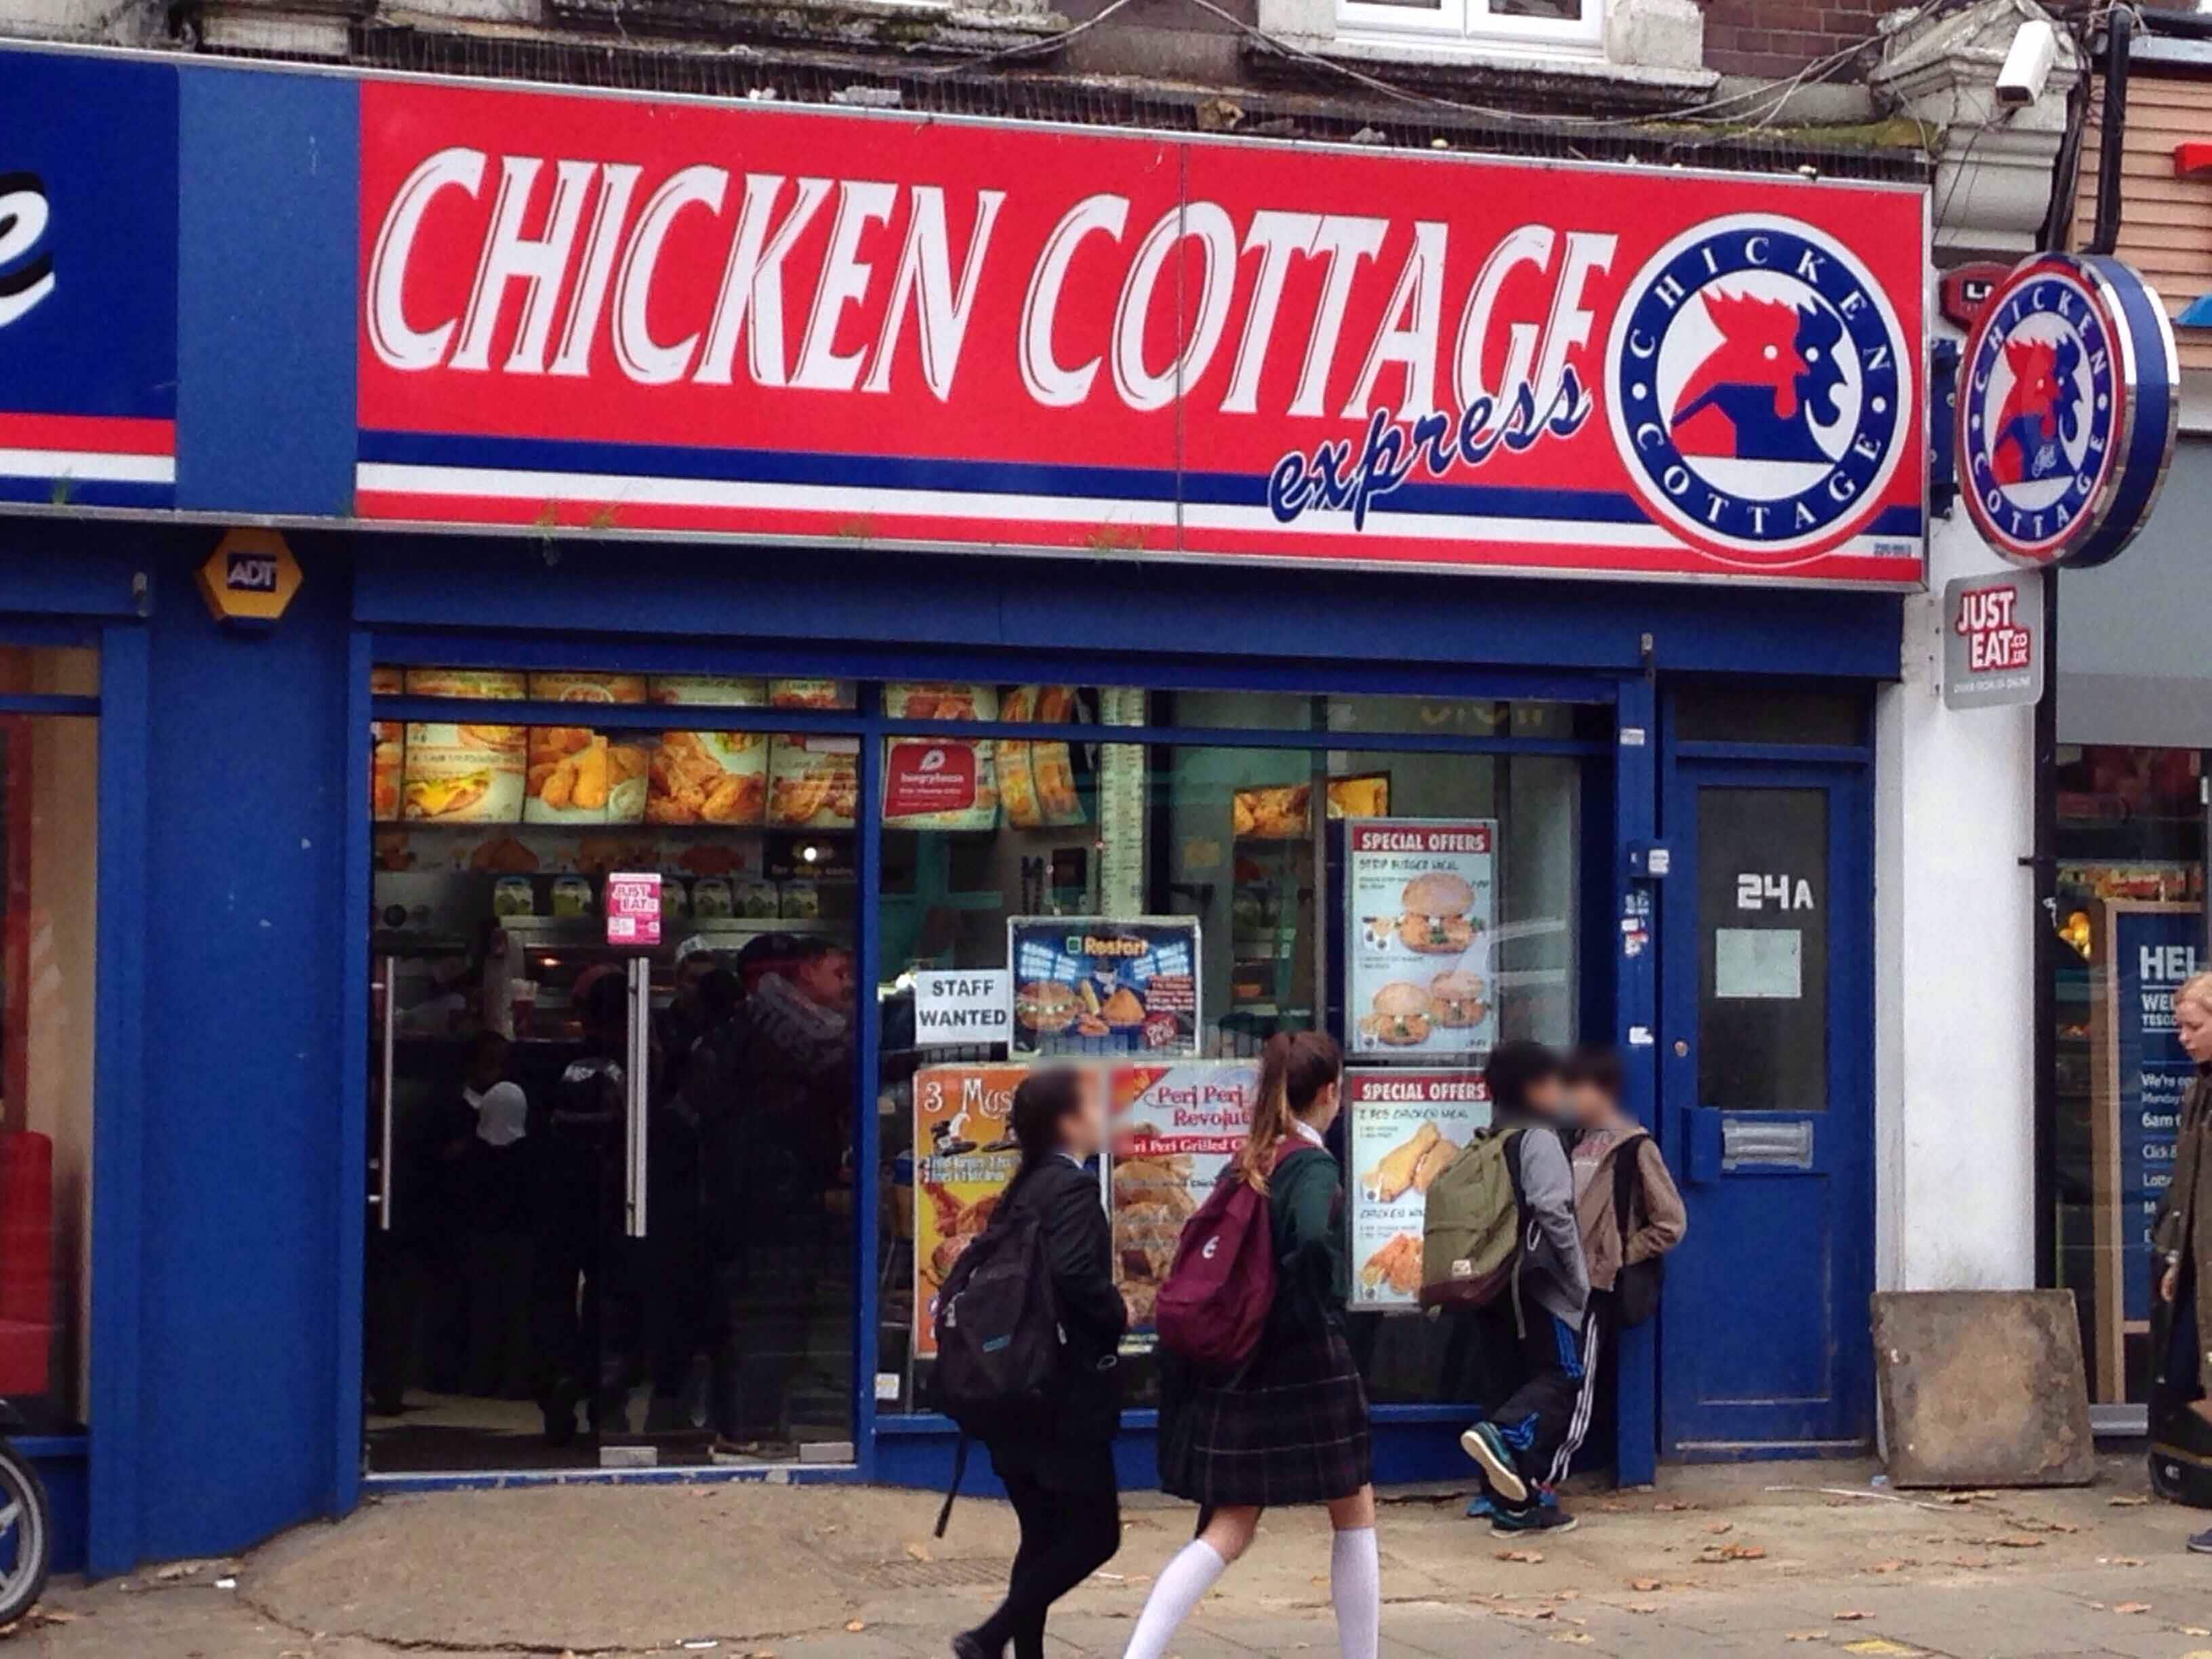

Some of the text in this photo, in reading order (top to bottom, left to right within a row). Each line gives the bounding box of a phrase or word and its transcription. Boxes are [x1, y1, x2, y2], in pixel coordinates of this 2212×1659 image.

[366, 146, 1618, 430] CHICKEN COTTAGE
[1630, 237, 1891, 371] CHICKEN
[1975, 285, 2108, 392] CHICKEN
[1269, 365, 1592, 532] express
[1637, 422, 1882, 535] COTTAGE
[1975, 436, 2104, 538] COTTAGE
[227, 560, 276, 586] ADT
[1958, 592, 2014, 632] JUST
[1971, 630, 2014, 668] EAT
[1361, 832, 1485, 851] SPECIAL OFFERS
[1737, 874, 1814, 910] 24A
[933, 980, 994, 997] STAFF
[919, 1008, 1006, 1027] WANTED
[924, 1081, 943, 1113] 3
[1158, 1084, 1243, 1109] Peri Peri
[1361, 1082, 1486, 1101] SPECIAL OFFERS
[1180, 1139, 1228, 1151] Grilled
